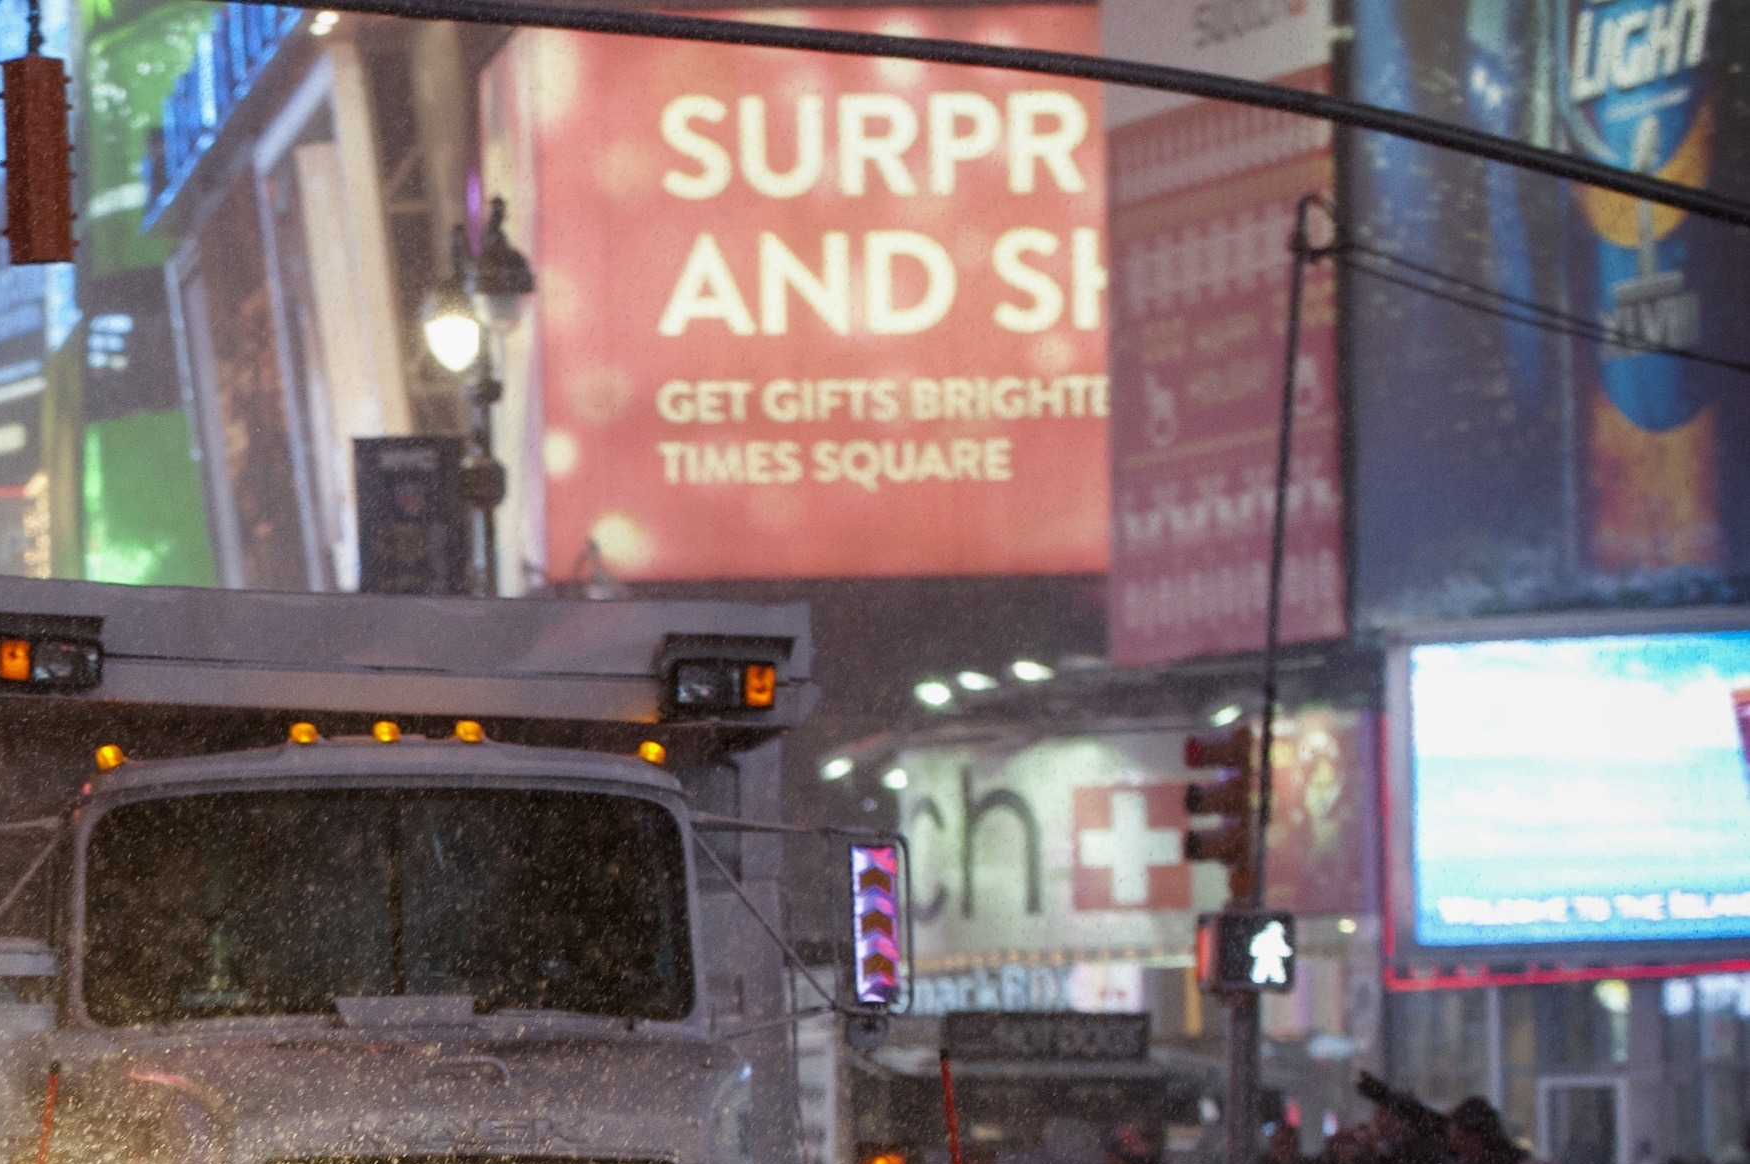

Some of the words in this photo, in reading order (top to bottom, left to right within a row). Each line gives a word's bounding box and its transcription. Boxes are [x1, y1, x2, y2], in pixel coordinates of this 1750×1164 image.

[659, 91, 1089, 200] SURPR
[658, 230, 957, 337] AND
[657, 379, 752, 424] GET
[762, 377, 900, 423] GIFTS
[658, 440, 804, 485] TIMES
[811, 437, 1014, 493] SQUARE
